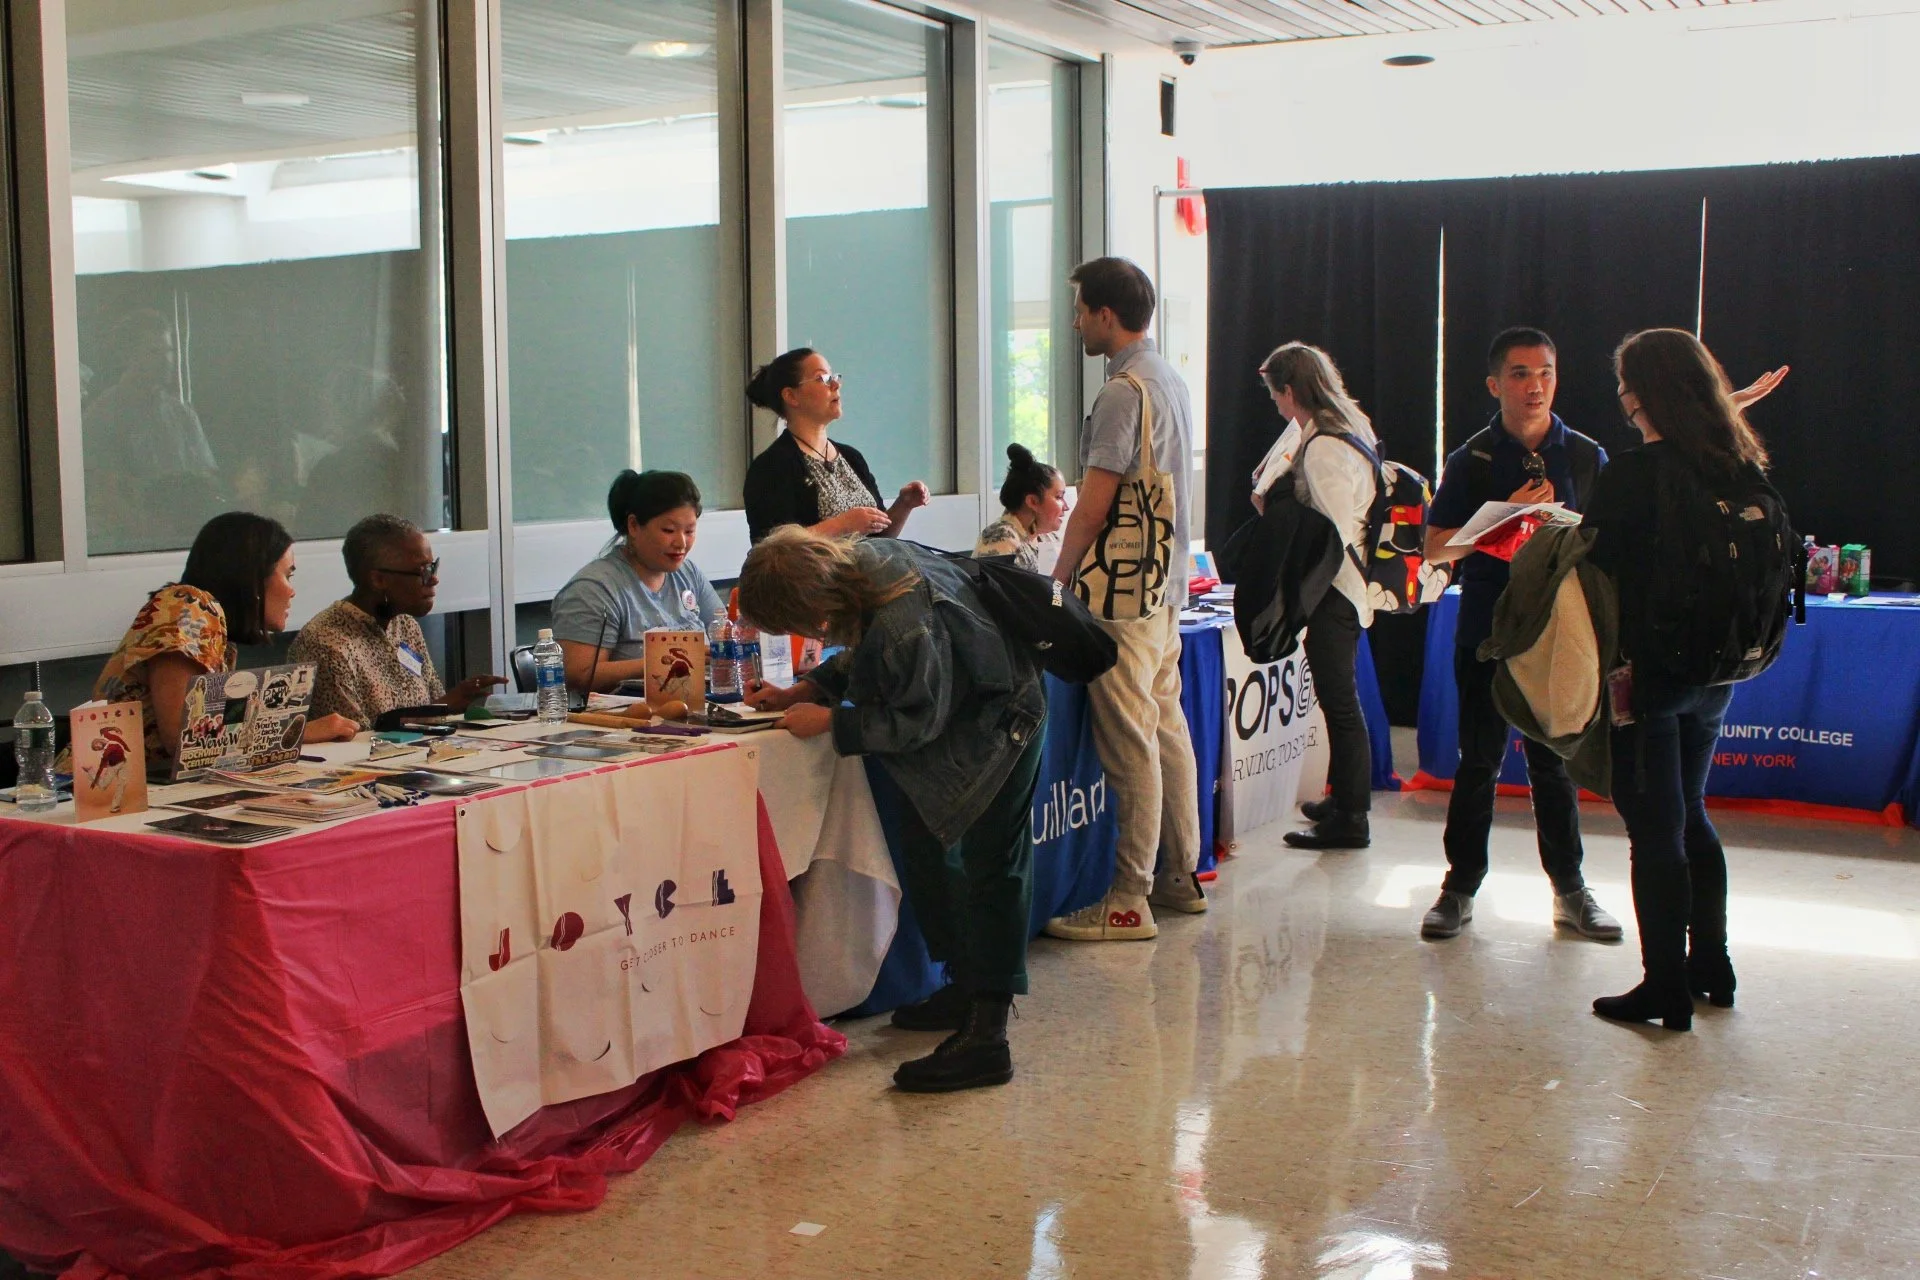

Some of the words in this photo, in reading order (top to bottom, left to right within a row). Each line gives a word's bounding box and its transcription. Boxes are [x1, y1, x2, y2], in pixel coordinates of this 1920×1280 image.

[1778, 727, 1854, 747] COLLEGE
[1711, 753, 1748, 766] NEW
[1752, 754, 1797, 769] YORK
[488, 868, 736, 972] JOYCE
[620, 956, 640, 971] GET
[671, 935, 684, 949] TO
[690, 926, 735, 943] DANCE
